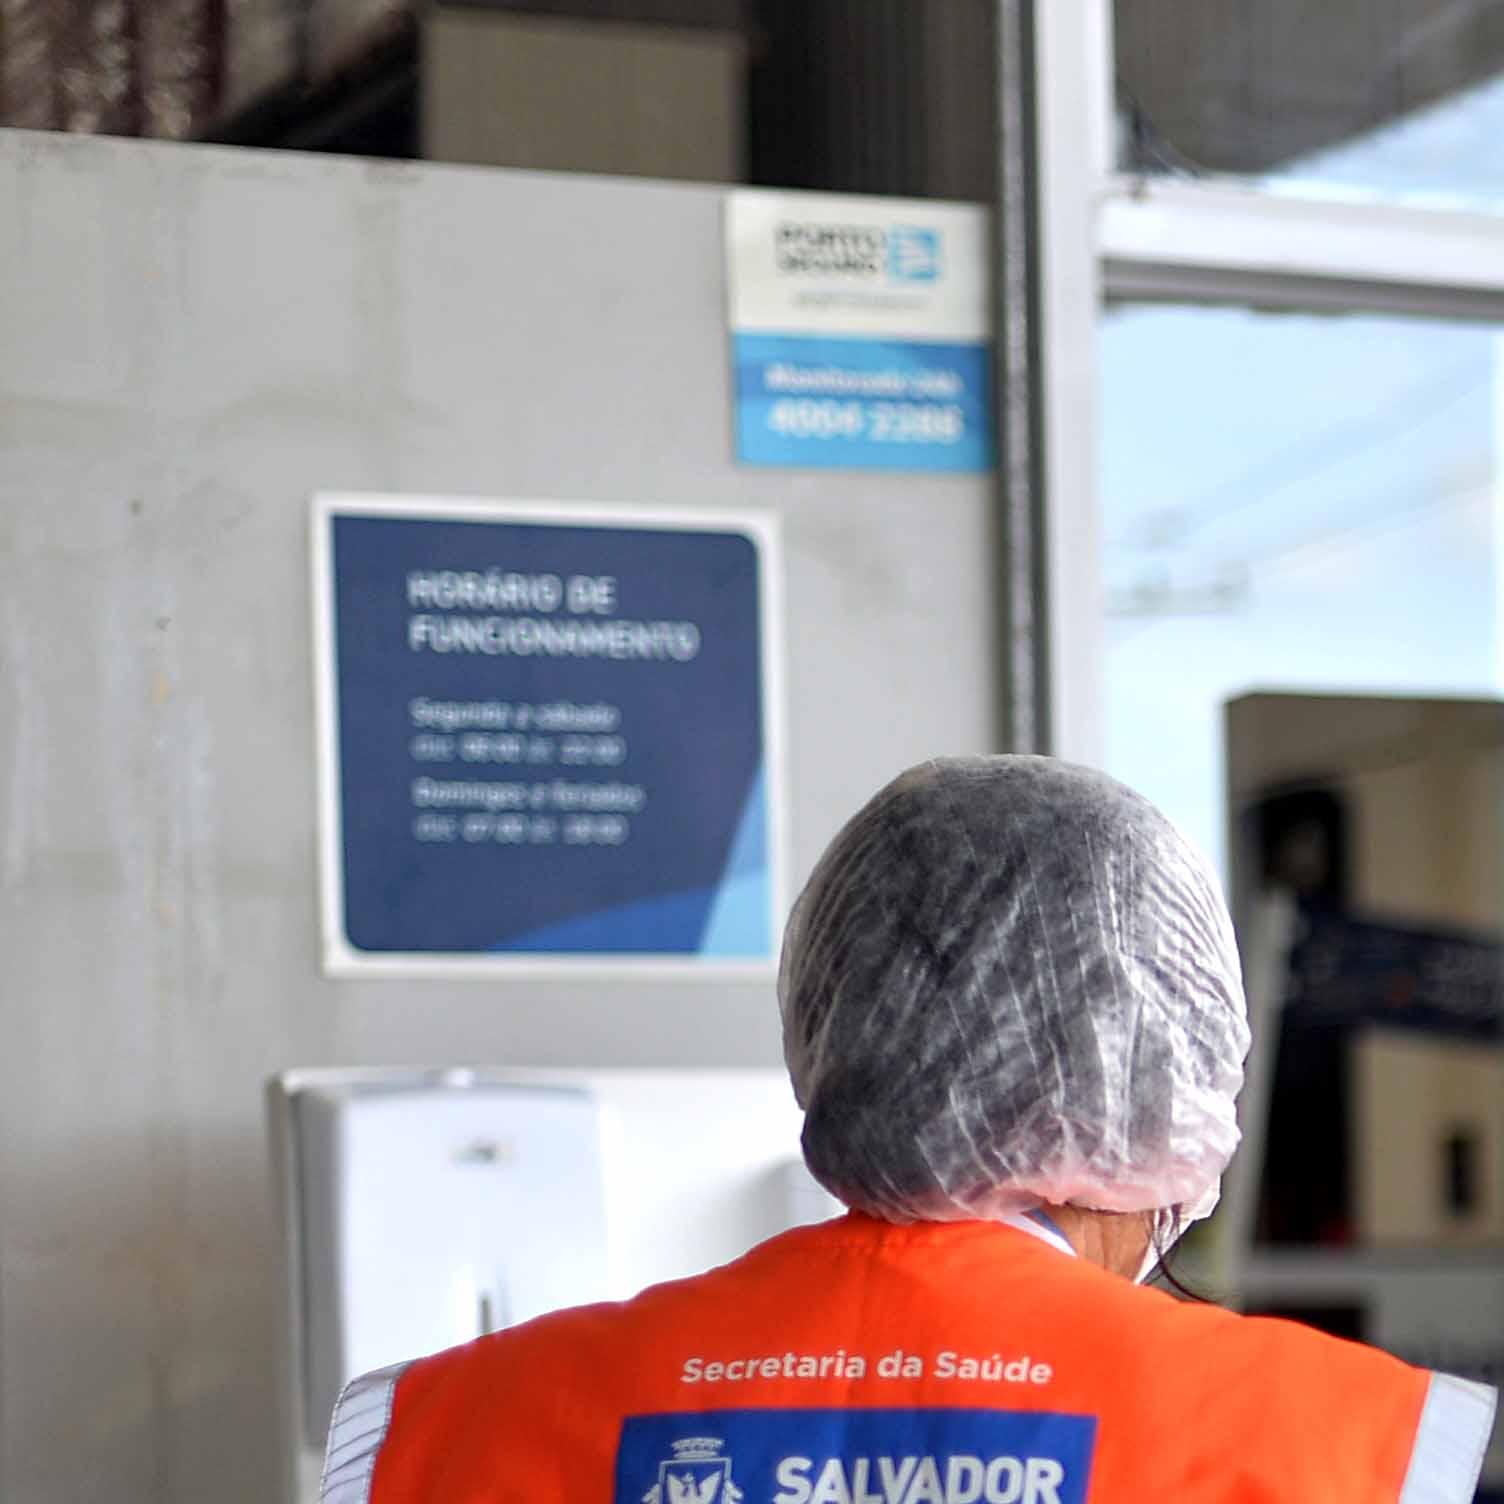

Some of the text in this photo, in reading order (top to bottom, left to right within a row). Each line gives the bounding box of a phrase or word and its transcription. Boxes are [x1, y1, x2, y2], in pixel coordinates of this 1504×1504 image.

[407, 568, 616, 613] HORÁRIO DE
[407, 617, 699, 662] FUNCIONAMENTO
[680, 1349, 1052, 1385] Secretaria da Saúde
